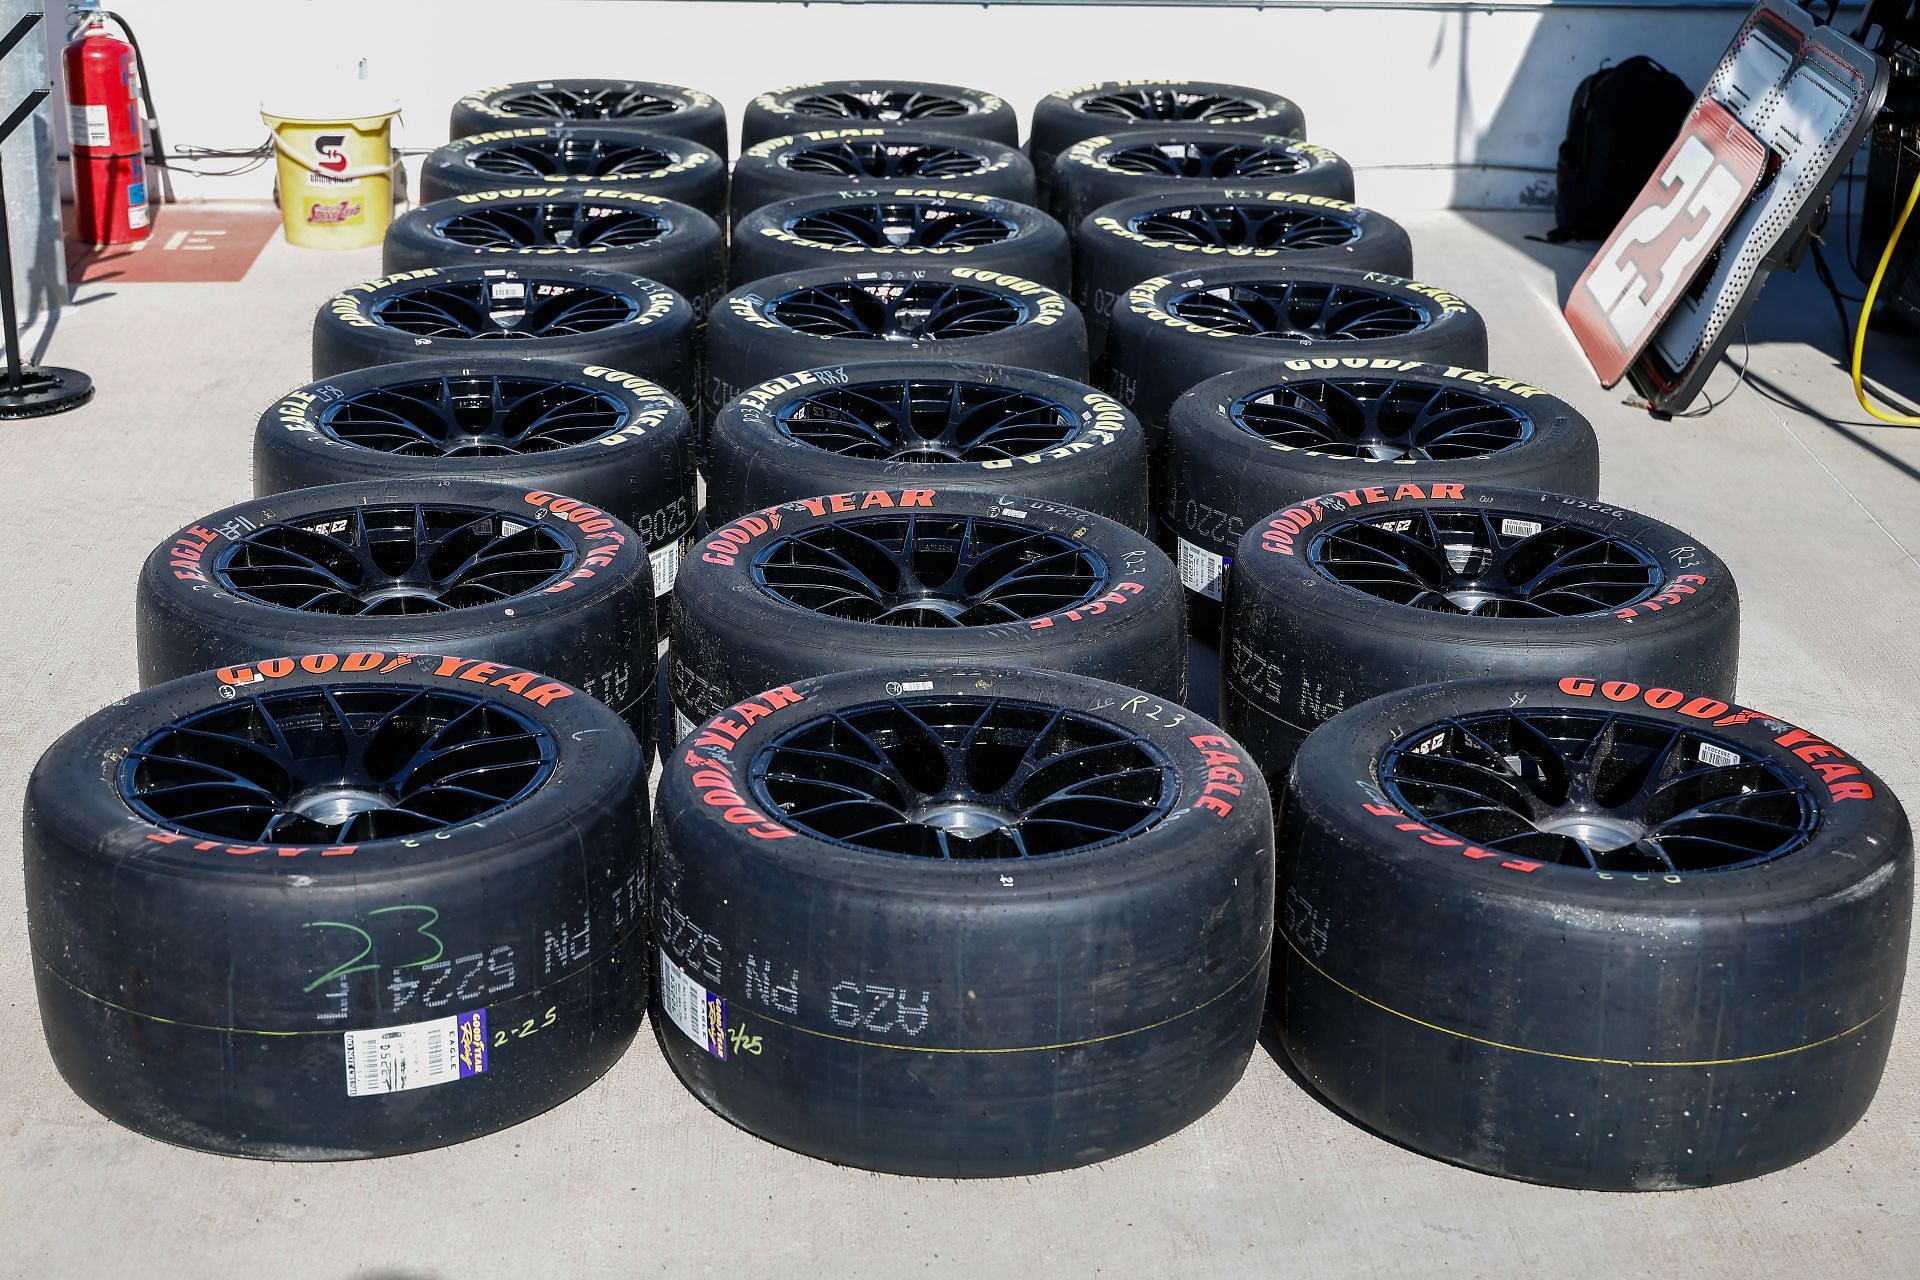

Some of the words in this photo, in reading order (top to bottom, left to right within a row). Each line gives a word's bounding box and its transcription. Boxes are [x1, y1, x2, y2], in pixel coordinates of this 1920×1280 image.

[738, 369, 818, 412] EAGLE
[1442, 365, 1551, 399] YEAR
[523, 488, 604, 534] GOOD
[702, 516, 770, 567] GOOD
[796, 488, 938, 518] YEAR
[1261, 504, 1315, 556] GOOD
[1335, 482, 1467, 508] YEAR
[170, 524, 219, 583] EAGLE
[1029, 581, 1146, 632] EAGLE
[1607, 573, 1708, 621] EAGLE
[215, 652, 386, 687] GOOD
[431, 652, 575, 709] YEAR
[693, 683, 807, 753] YEAR
[1119, 694, 1187, 729] R23
[1556, 676, 1731, 727] GOOD
[1772, 726, 1876, 805] YEAR
[691, 769, 799, 841] GOOD
[1187, 733, 1236, 820] EAGLE
[301, 903, 445, 994] 23
[385, 943, 517, 1015] 5224
[744, 953, 800, 1016] PN
[829, 980, 930, 1037] A29
[449, 1030, 458, 1071] EAGLE
